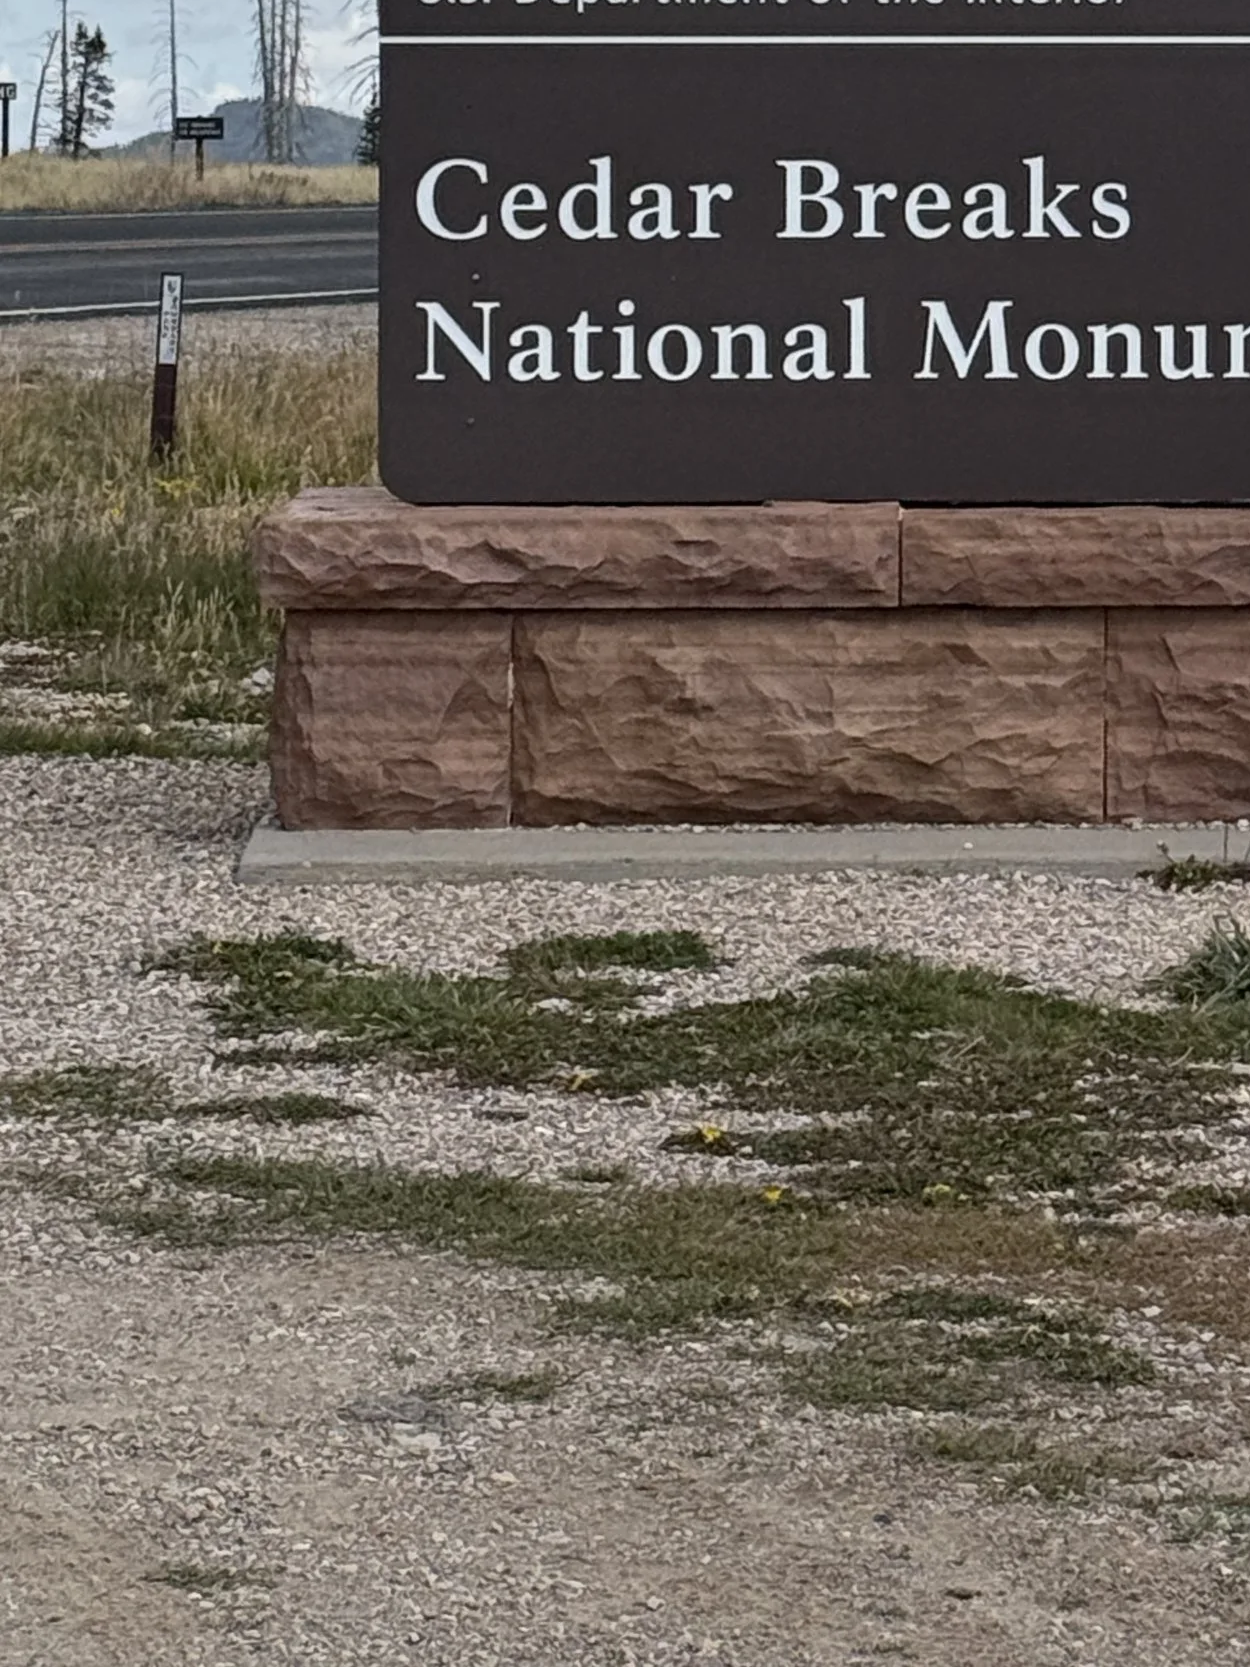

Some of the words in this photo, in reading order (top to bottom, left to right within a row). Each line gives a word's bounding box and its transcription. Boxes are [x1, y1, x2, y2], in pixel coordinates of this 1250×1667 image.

[415, 155, 734, 240] Cedar
[775, 155, 1131, 240] Breaks
[415, 296, 872, 382] National
